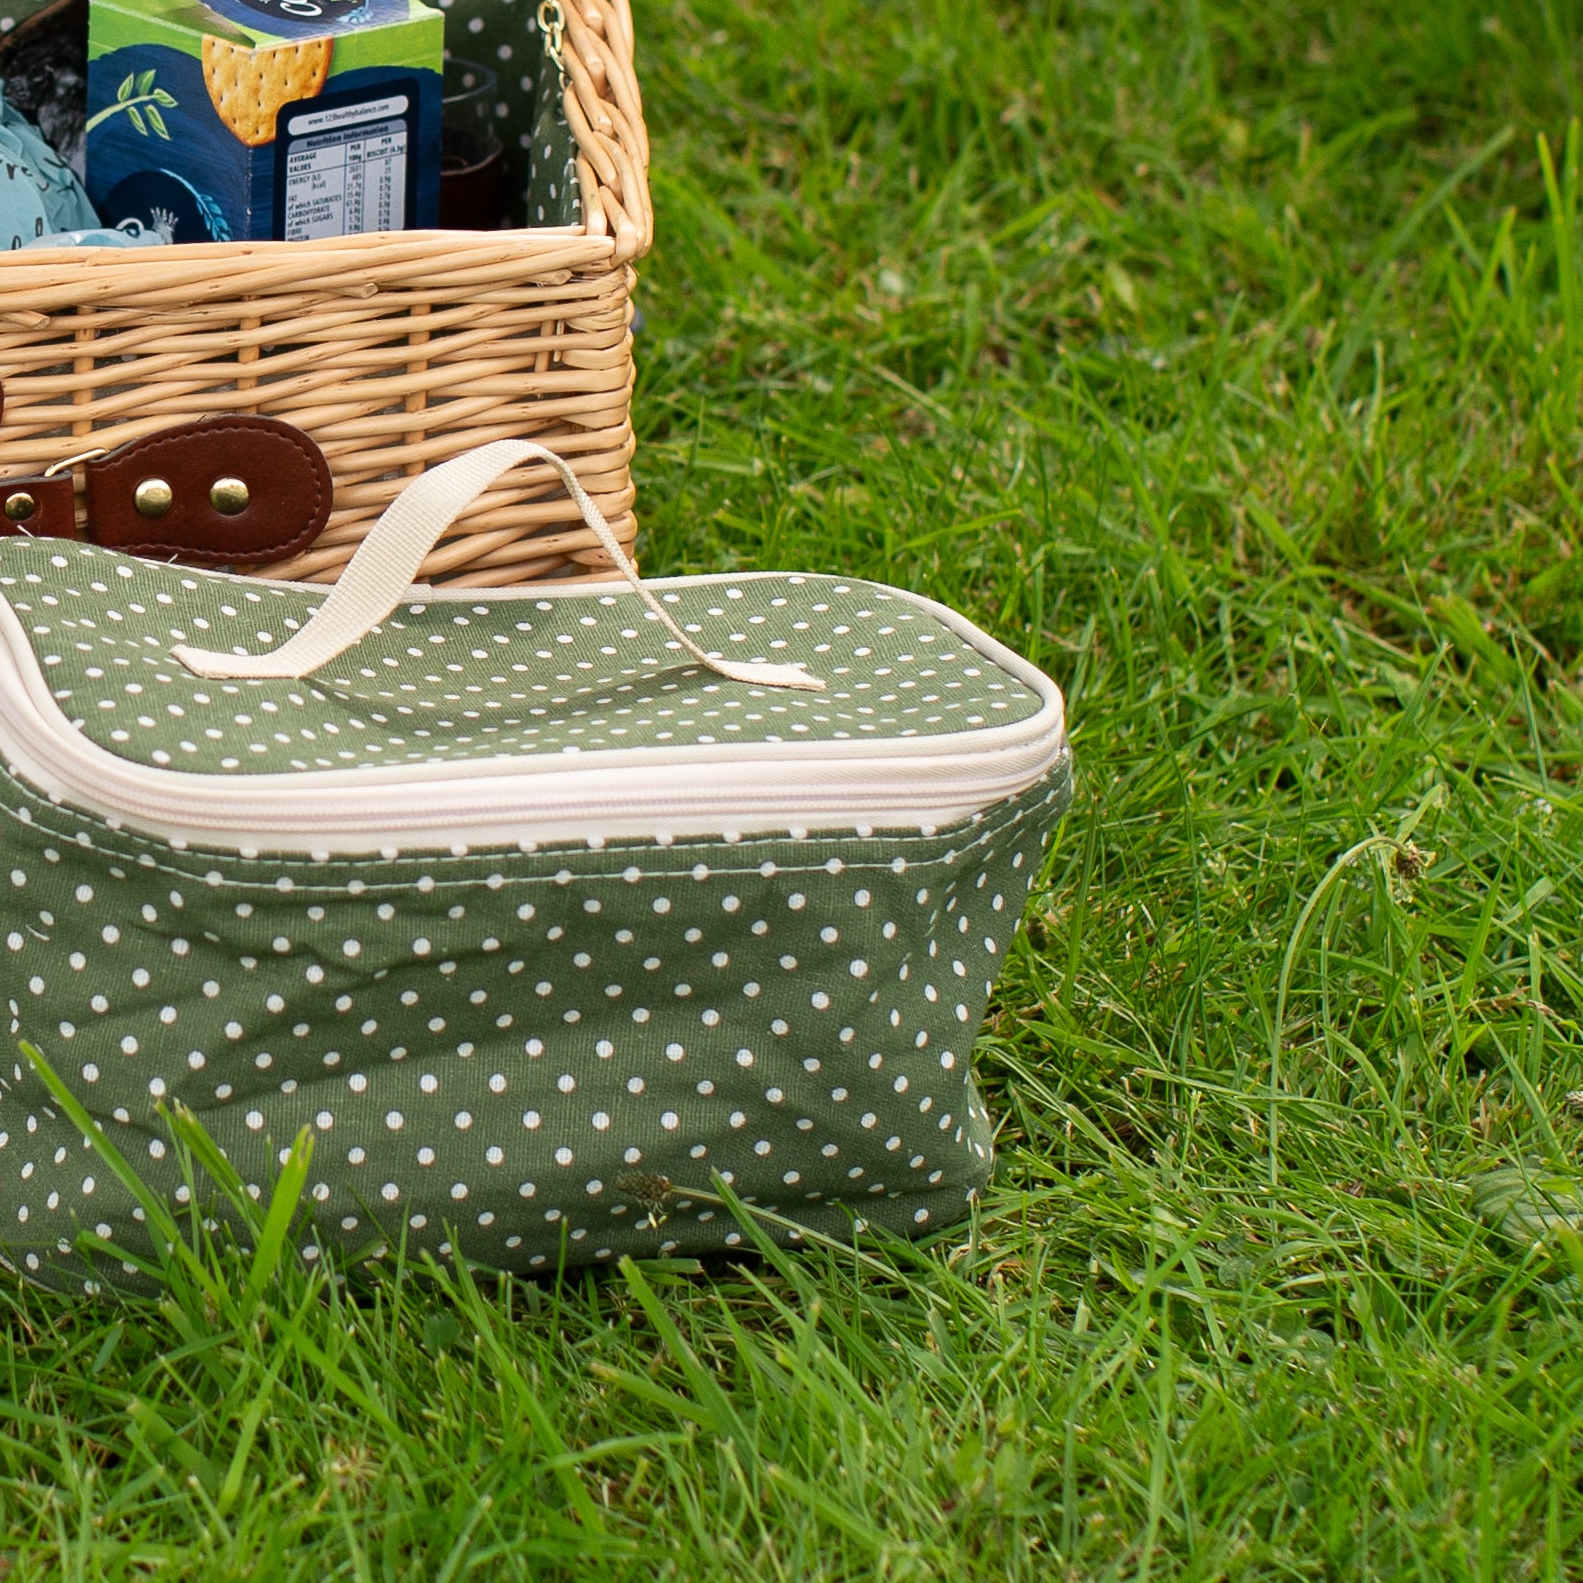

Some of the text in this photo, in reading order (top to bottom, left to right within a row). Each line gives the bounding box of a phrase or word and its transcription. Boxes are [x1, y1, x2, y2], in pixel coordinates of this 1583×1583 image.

[306, 125, 389, 149] Nutrition Information
[381, 137, 392, 145] PER
[350, 143, 361, 151] PER
[289, 152, 317, 163] AVERAGE
[289, 162, 311, 173] VALUES
[288, 175, 310, 186] ENERGY
[288, 194, 297, 202] FAT
